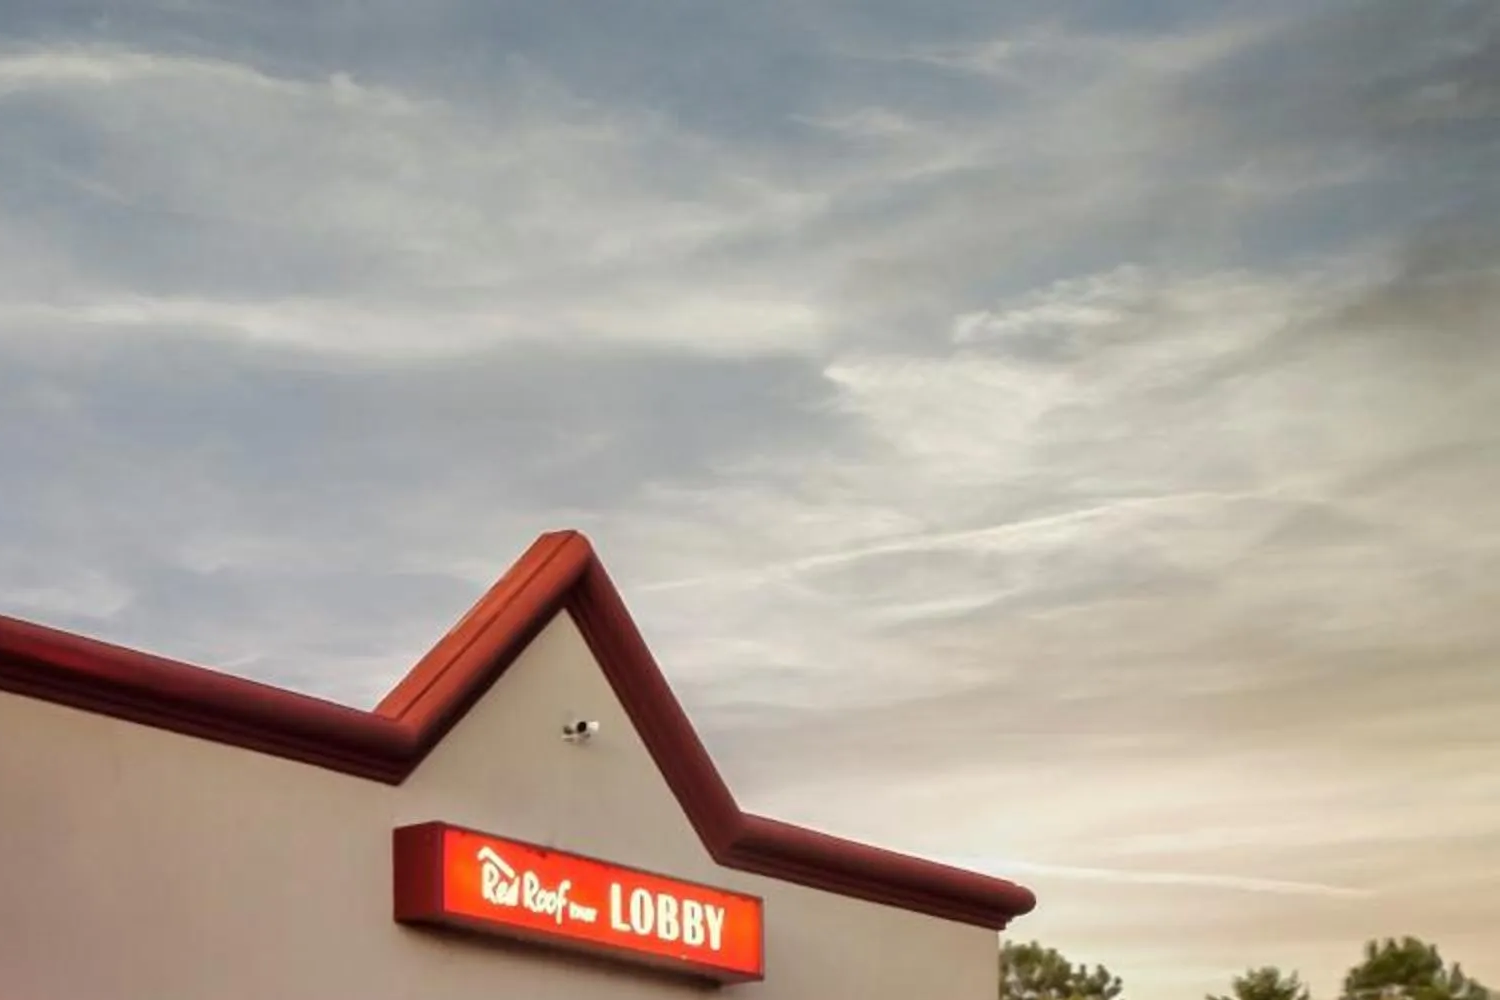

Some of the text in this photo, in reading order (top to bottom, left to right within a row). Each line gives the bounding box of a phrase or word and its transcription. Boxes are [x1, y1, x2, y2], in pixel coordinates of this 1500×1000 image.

[482, 861, 520, 907] Red
[523, 871, 571, 924] Roof
[610, 882, 725, 951] LOBBY
